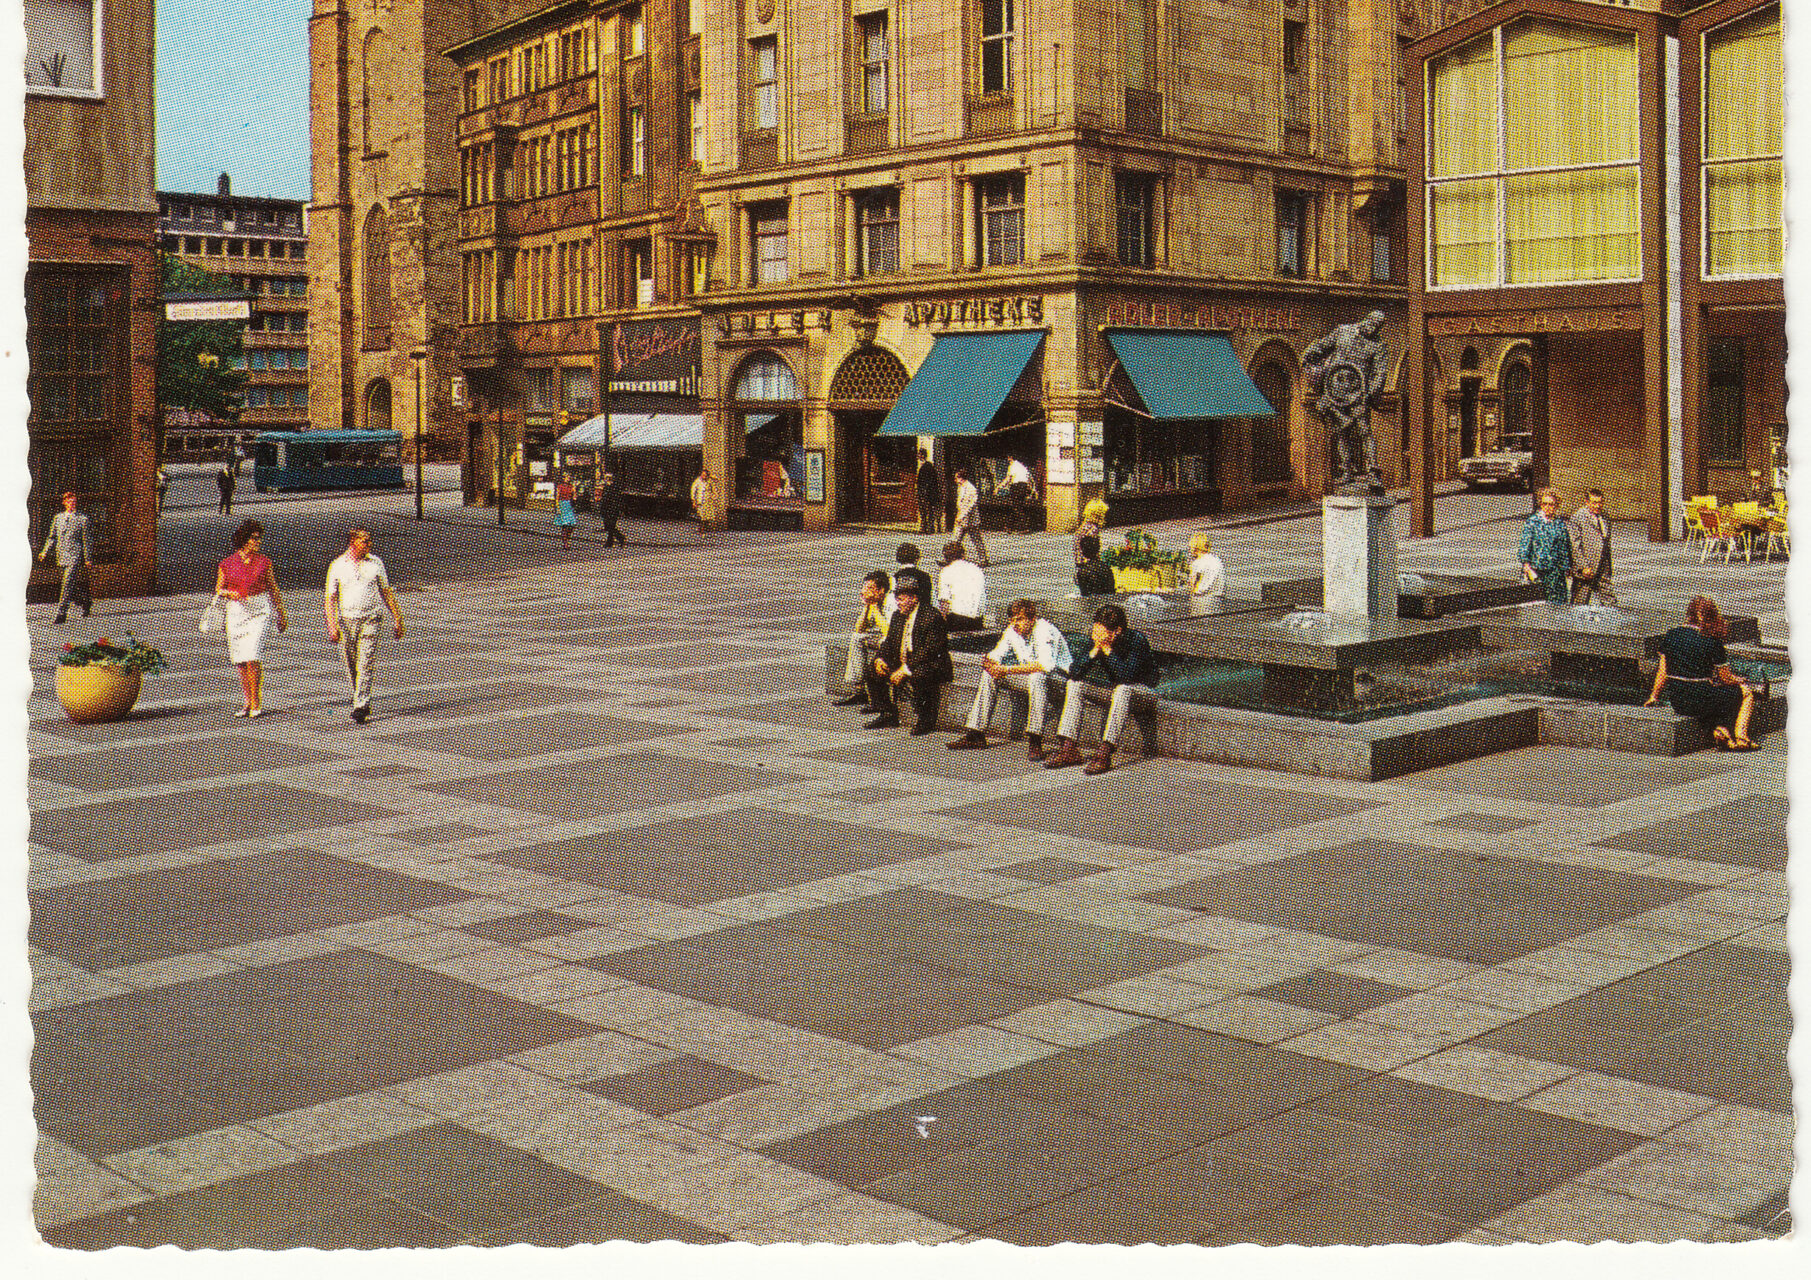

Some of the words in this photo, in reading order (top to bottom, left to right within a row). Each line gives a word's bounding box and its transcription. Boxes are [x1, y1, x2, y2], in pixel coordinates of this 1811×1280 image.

[717, 309, 832, 336] ADLER
[903, 295, 1045, 327] APOTHEKE
[1441, 311, 1626, 334] GASTHAUS
